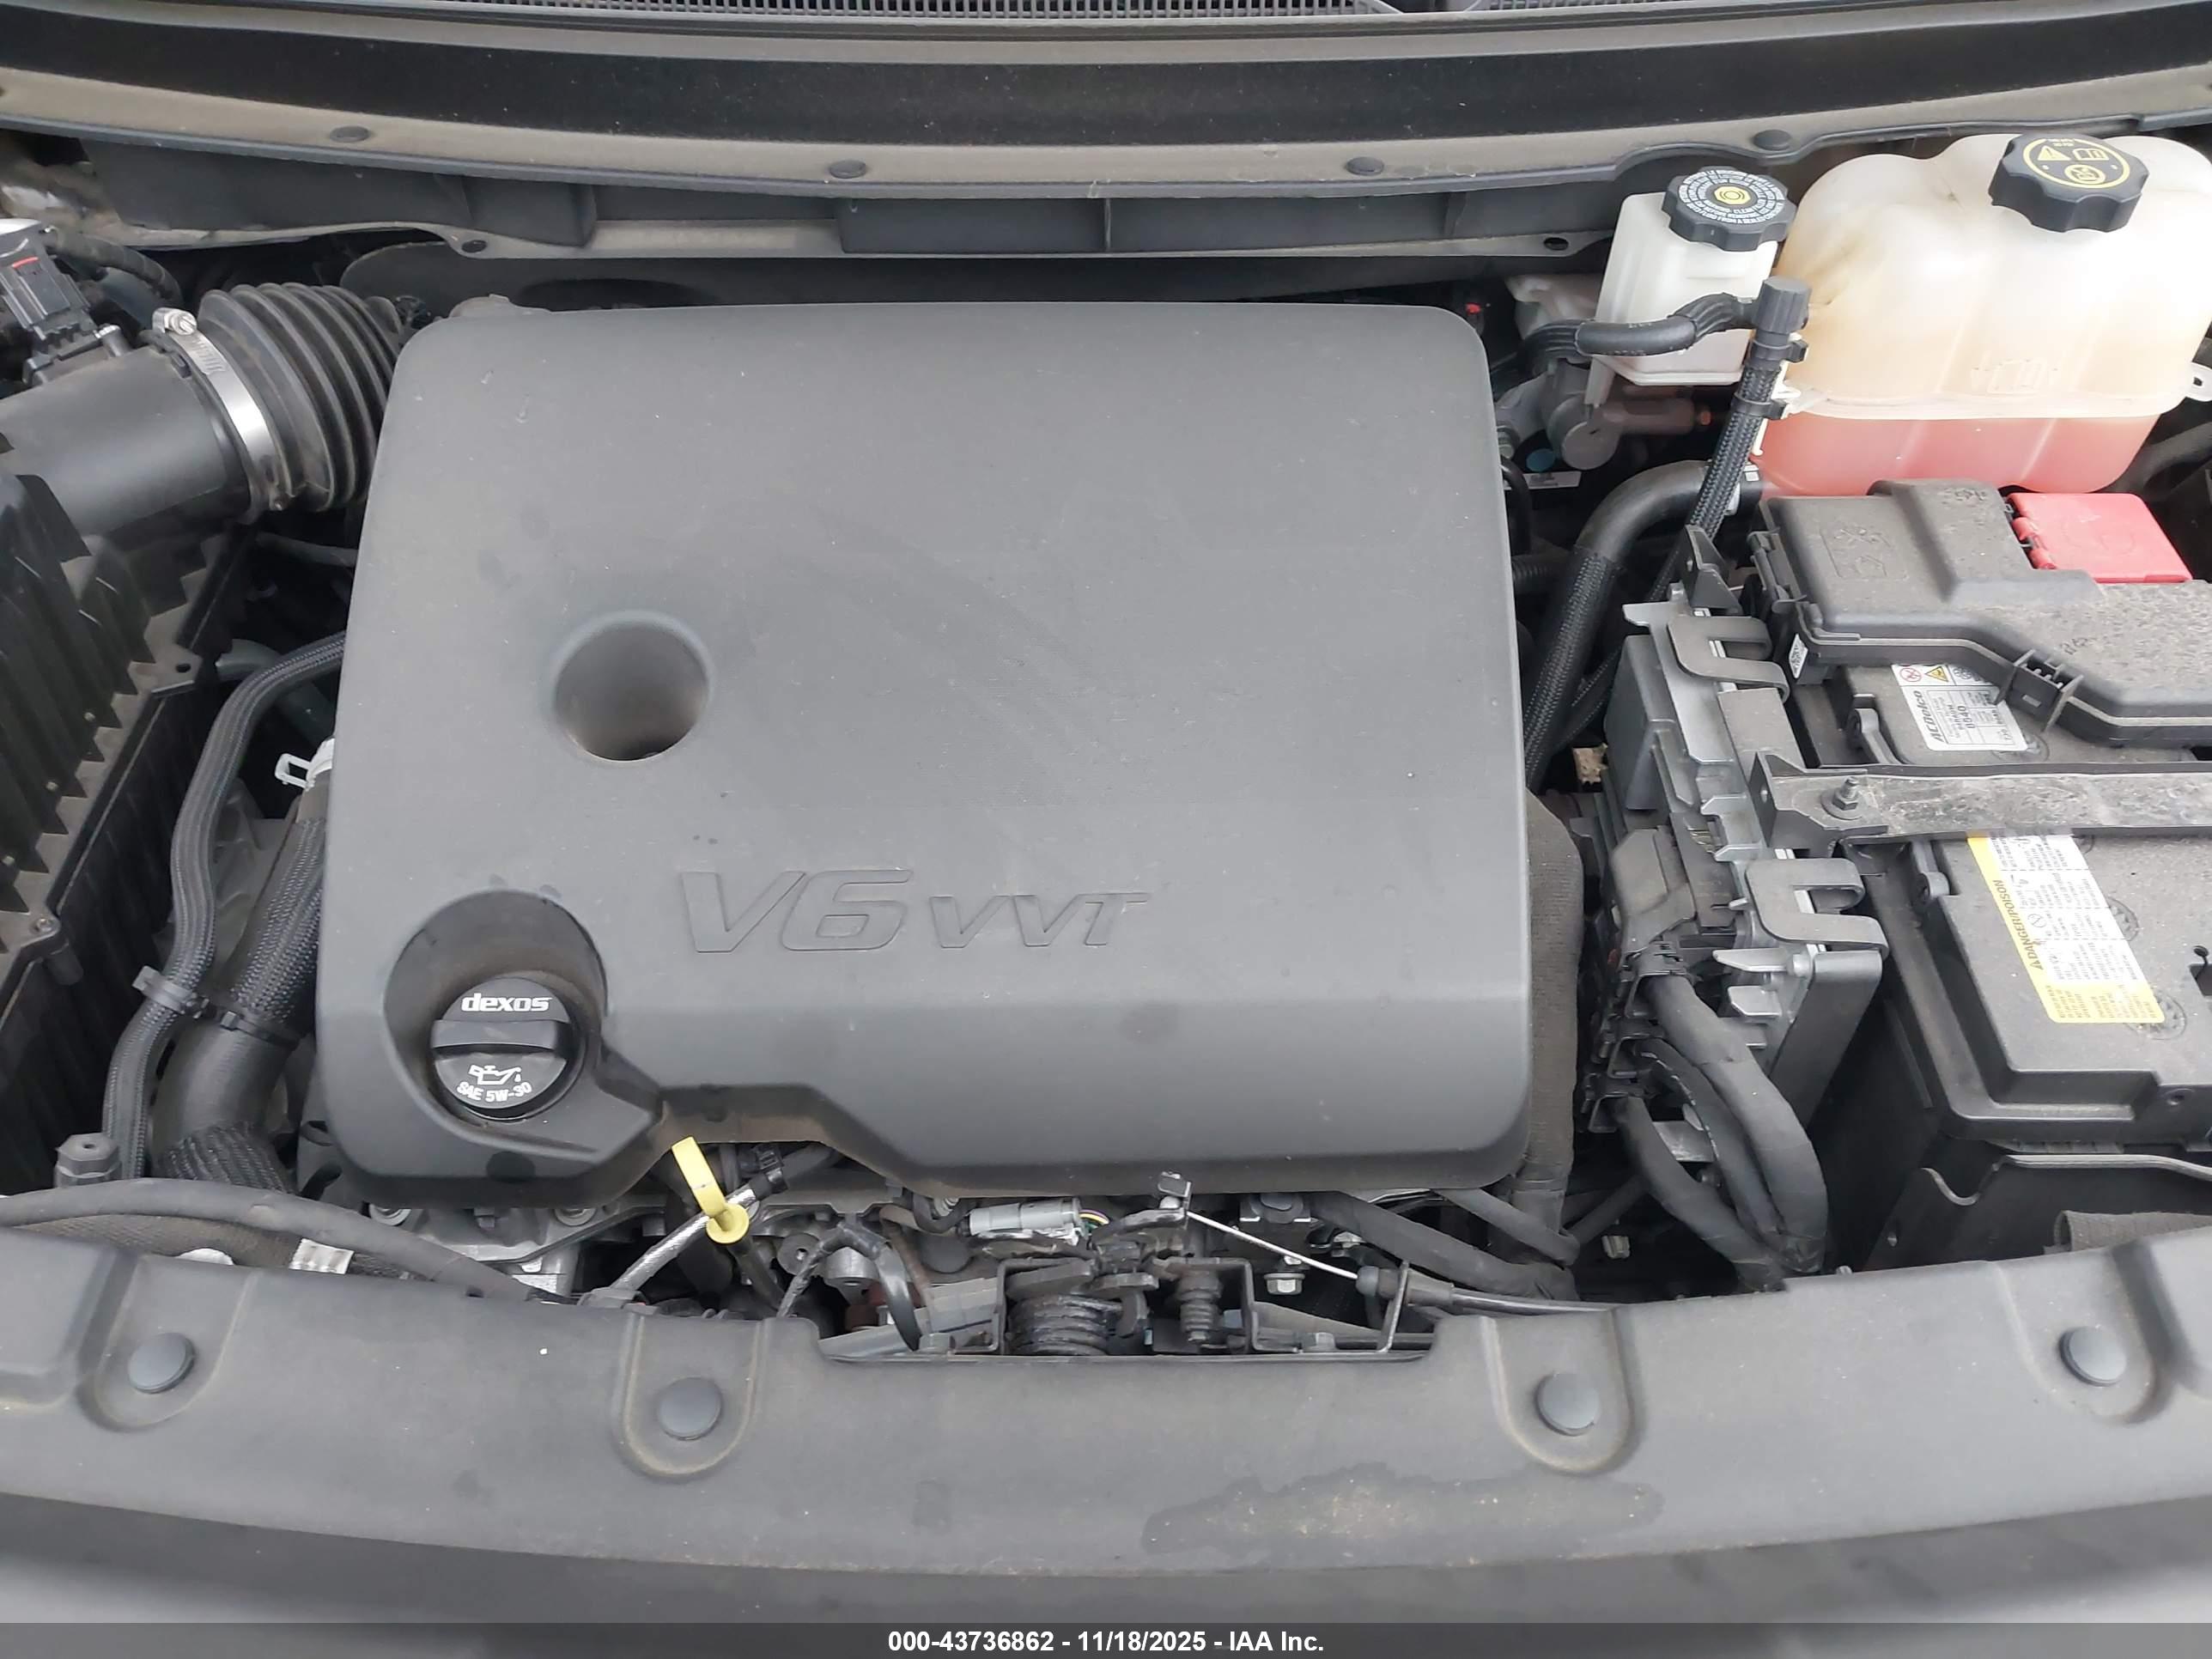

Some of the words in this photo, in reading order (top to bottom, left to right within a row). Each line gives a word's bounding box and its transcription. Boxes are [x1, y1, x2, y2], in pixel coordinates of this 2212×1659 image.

[1913, 690, 1944, 743] ACDelco
[680, 868, 914, 953] V6
[929, 892, 1151, 948] VVT
[1993, 879, 2038, 963] DANGER/POISON
[461, 993, 553, 1012] dexos
[457, 1081, 483, 1101] SAE
[485, 1082, 532, 1102] 5W-30
